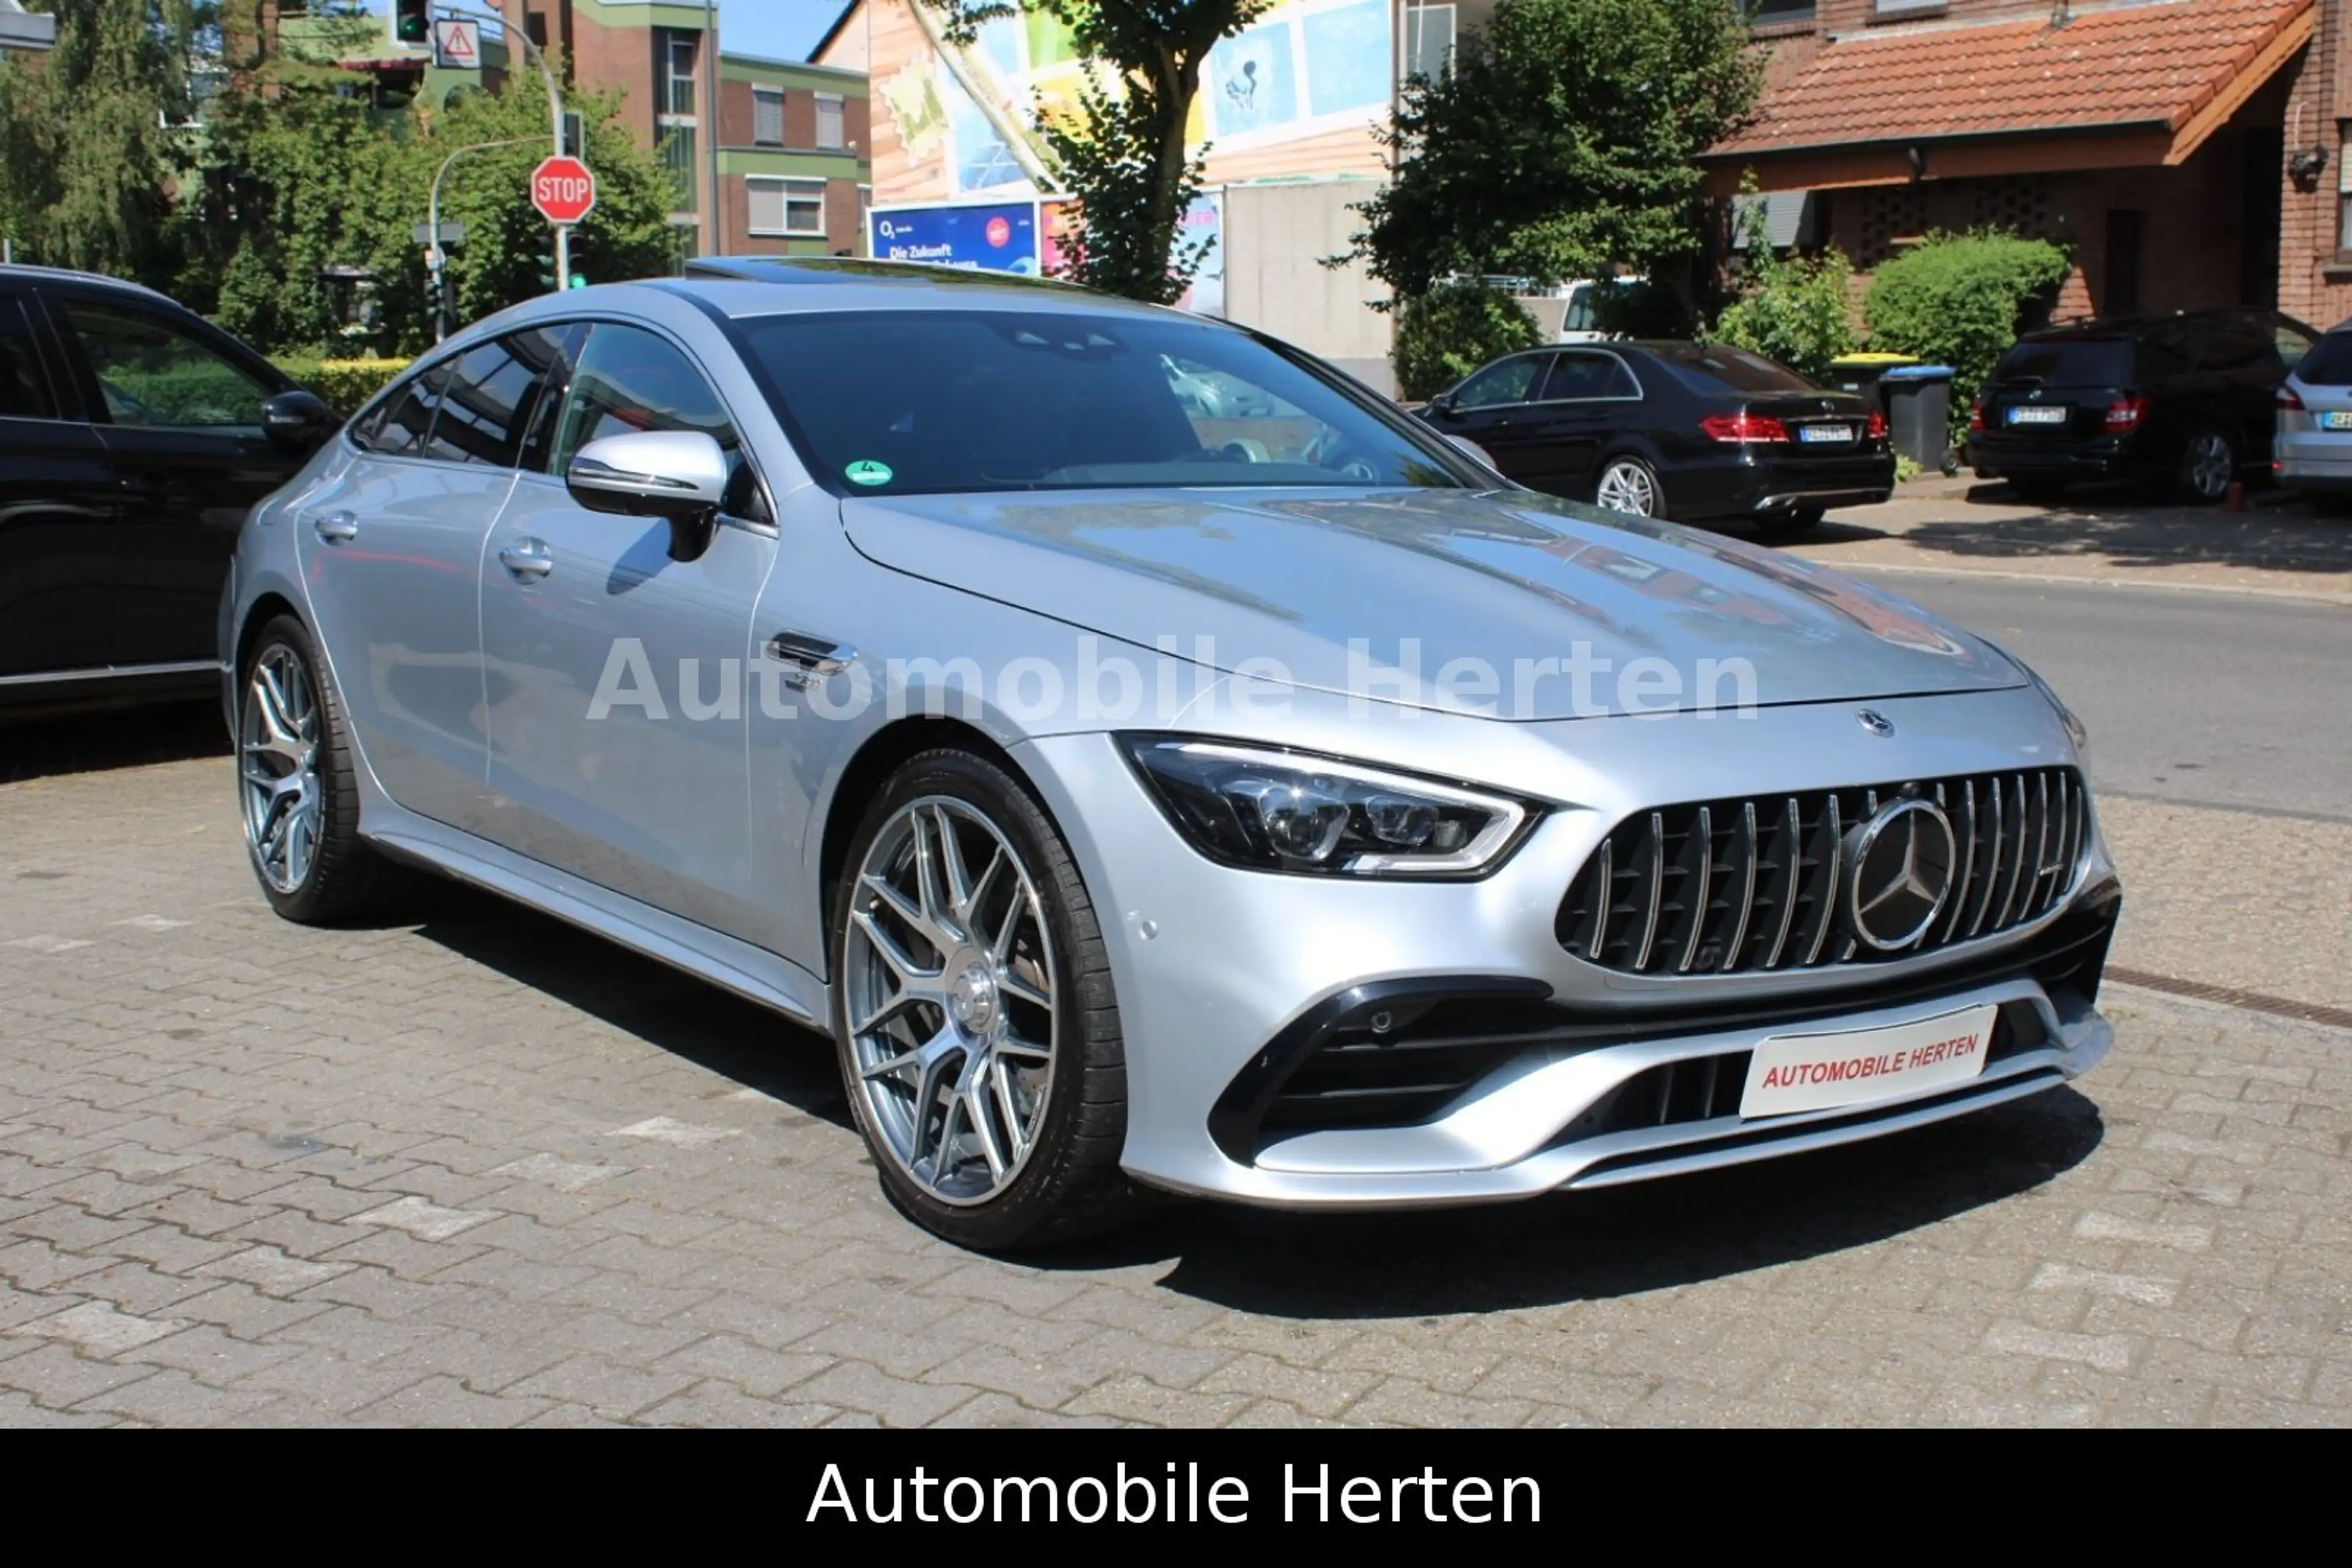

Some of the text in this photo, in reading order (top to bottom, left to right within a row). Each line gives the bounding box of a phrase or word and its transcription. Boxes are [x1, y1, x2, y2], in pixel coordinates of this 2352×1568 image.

[538, 176, 589, 203] STOP
[889, 243, 952, 260] Die Zukunft
[861, 461, 875, 473] 4
[1762, 1033, 1979, 1088] AUTOMOBILE HERTEN
